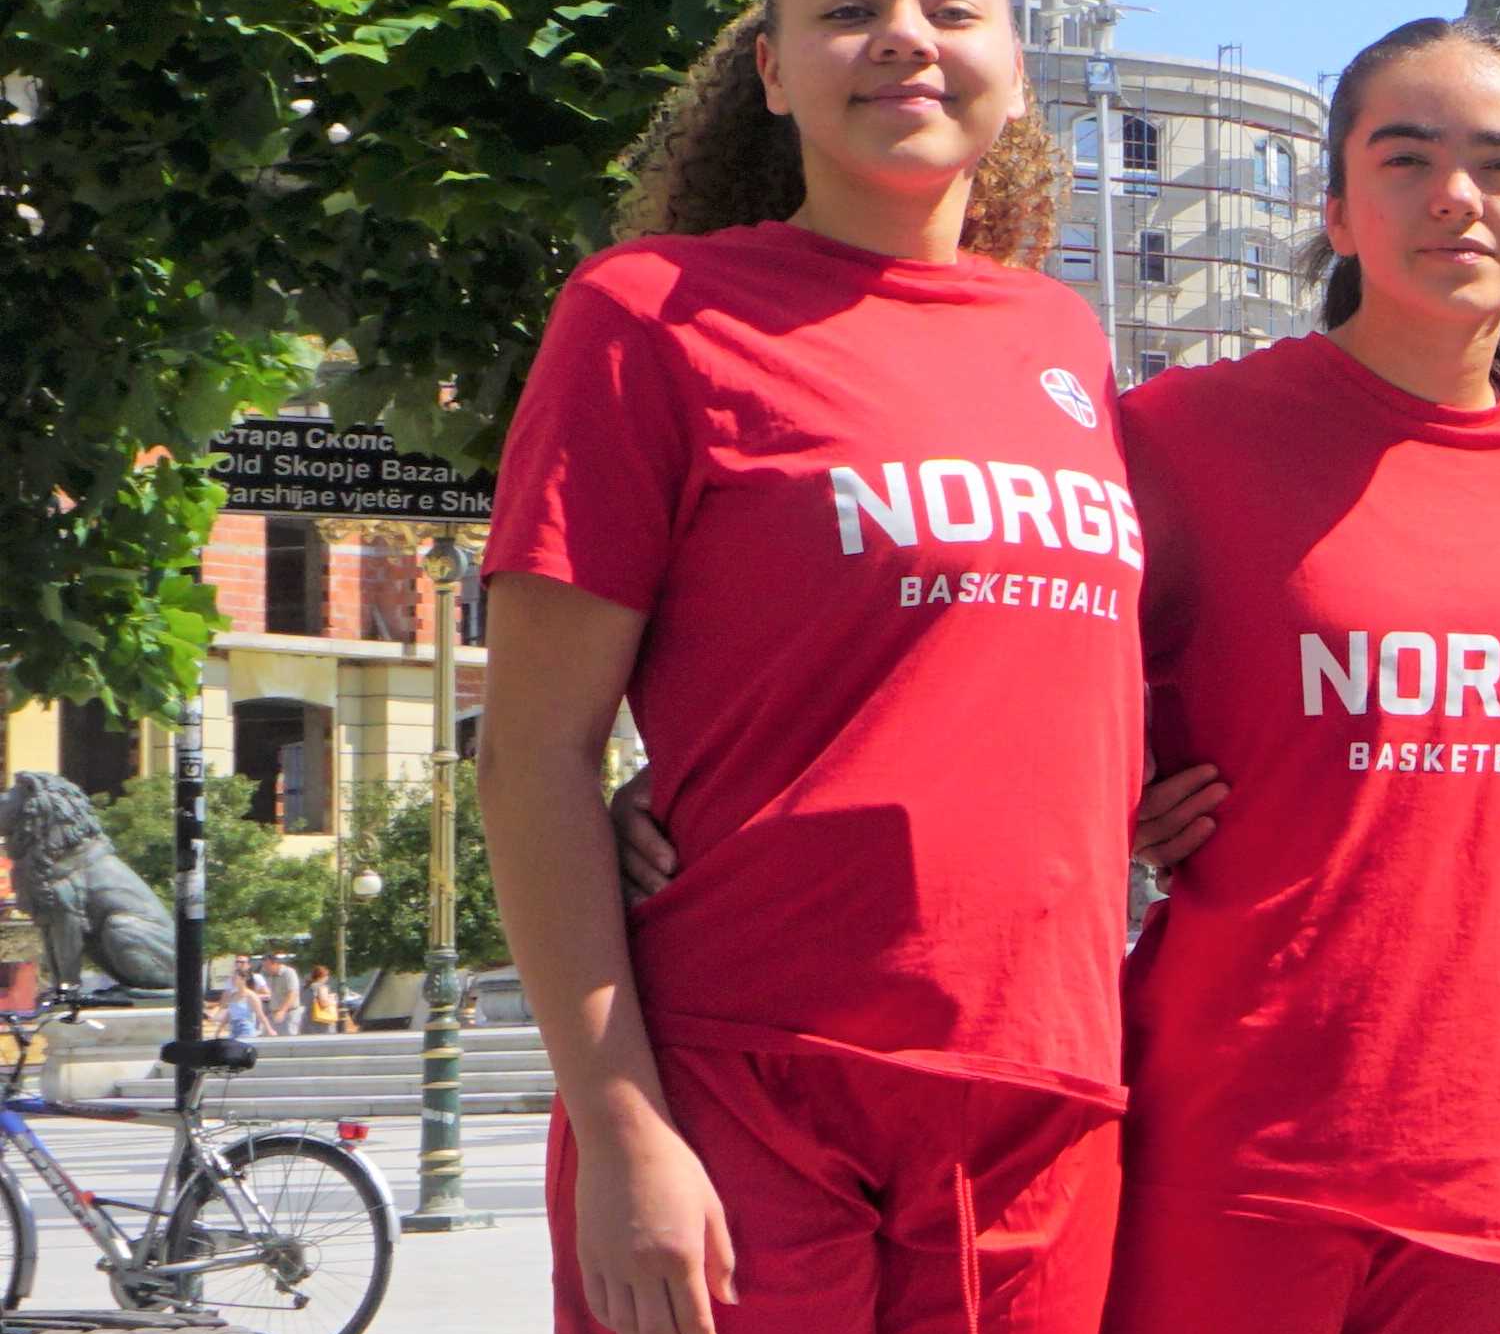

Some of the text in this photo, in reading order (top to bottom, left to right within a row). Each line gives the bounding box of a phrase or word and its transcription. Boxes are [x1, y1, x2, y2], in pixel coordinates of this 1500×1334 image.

[305, 427, 394, 451] Скопс
[274, 454, 370, 484] Skopje
[340, 488, 413, 512] vjetër
[418, 493, 433, 510] e
[441, 490, 493, 513] Shk
[830, 459, 1143, 570] NORGE
[901, 573, 1119, 621] BASKETBALL
